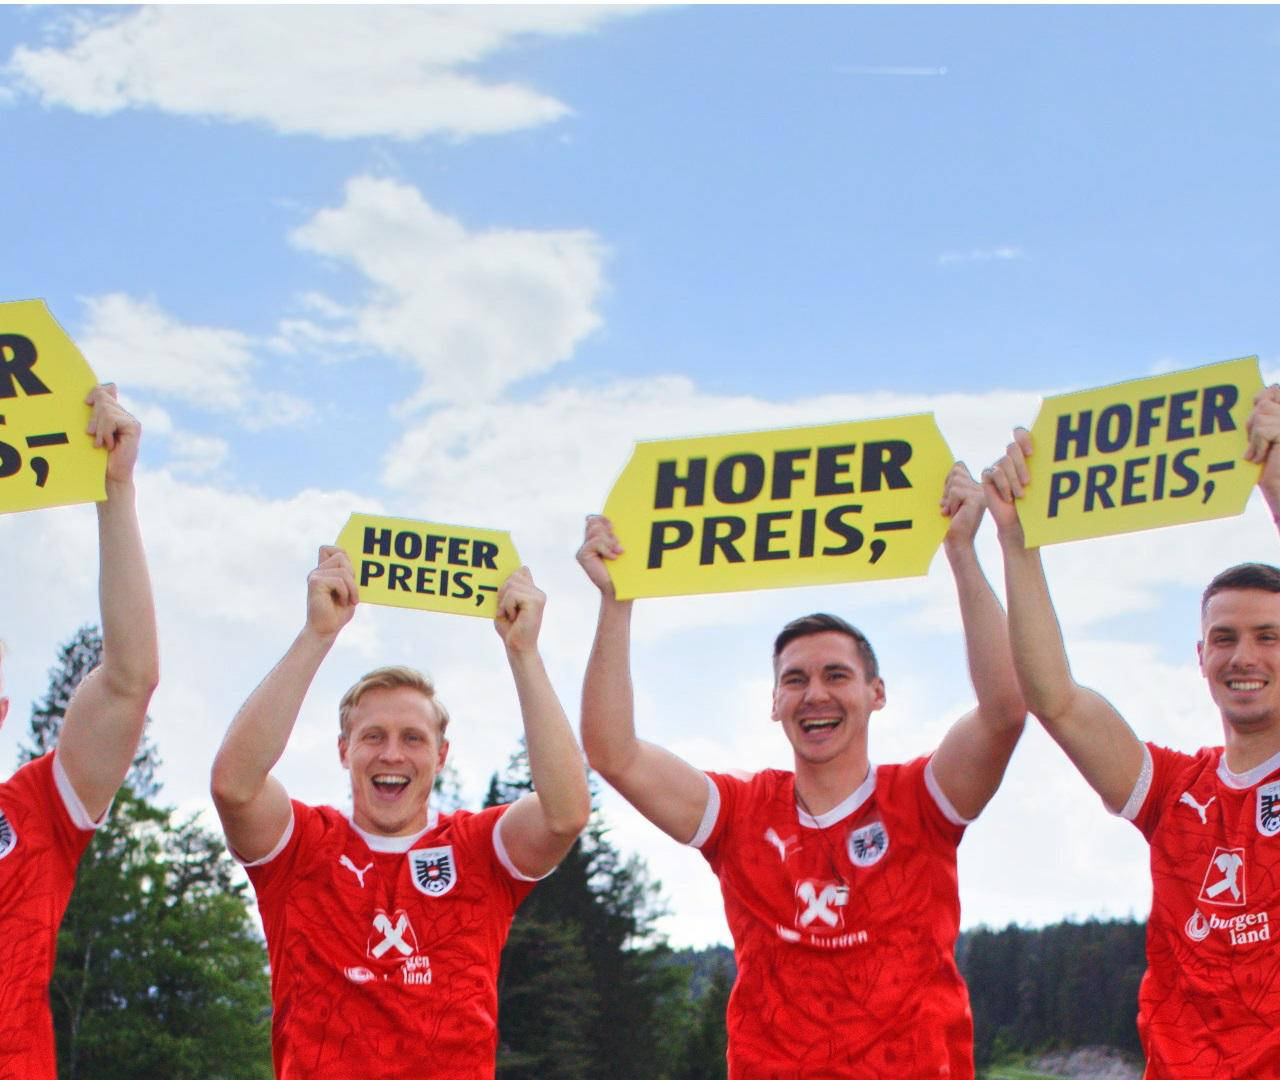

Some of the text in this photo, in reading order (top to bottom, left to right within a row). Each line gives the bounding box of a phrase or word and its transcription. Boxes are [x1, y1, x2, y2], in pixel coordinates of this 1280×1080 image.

[1053, 384, 1239, 462] HOFER
[654, 440, 913, 510] HOFER
[362, 526, 499, 570] HOFER
[1209, 911, 1268, 931] burgen
[1229, 923, 1270, 945] land
